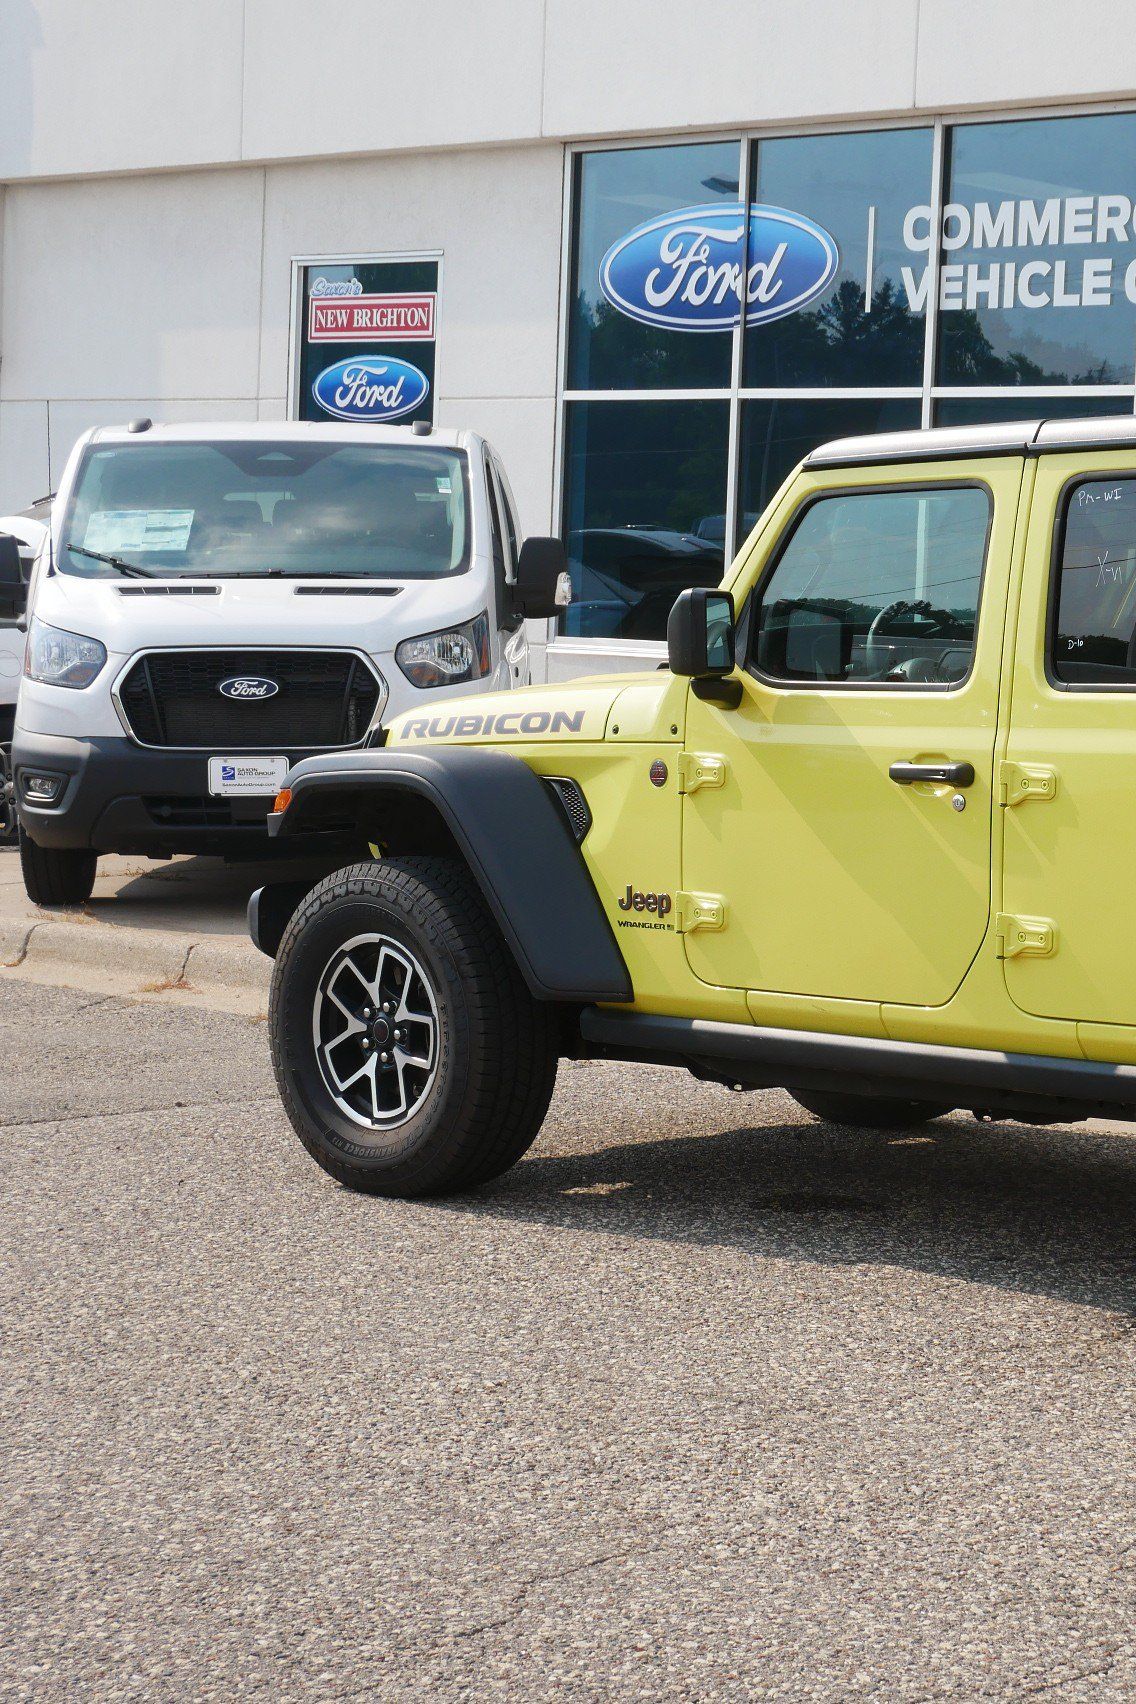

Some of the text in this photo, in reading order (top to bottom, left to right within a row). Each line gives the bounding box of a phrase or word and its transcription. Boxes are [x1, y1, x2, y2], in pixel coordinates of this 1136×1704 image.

[643, 225, 784, 306] Ford
[311, 277, 363, 296] Saxon's
[900, 258, 1113, 312] VEHICLE
[316, 307, 428, 328] NEW BRIGHTON
[335, 364, 404, 408] Ford
[230, 681, 267, 695] Ford
[400, 711, 585, 739] RUBICON
[618, 885, 671, 918] Jeep
[617, 920, 665, 930] WRANGLER
